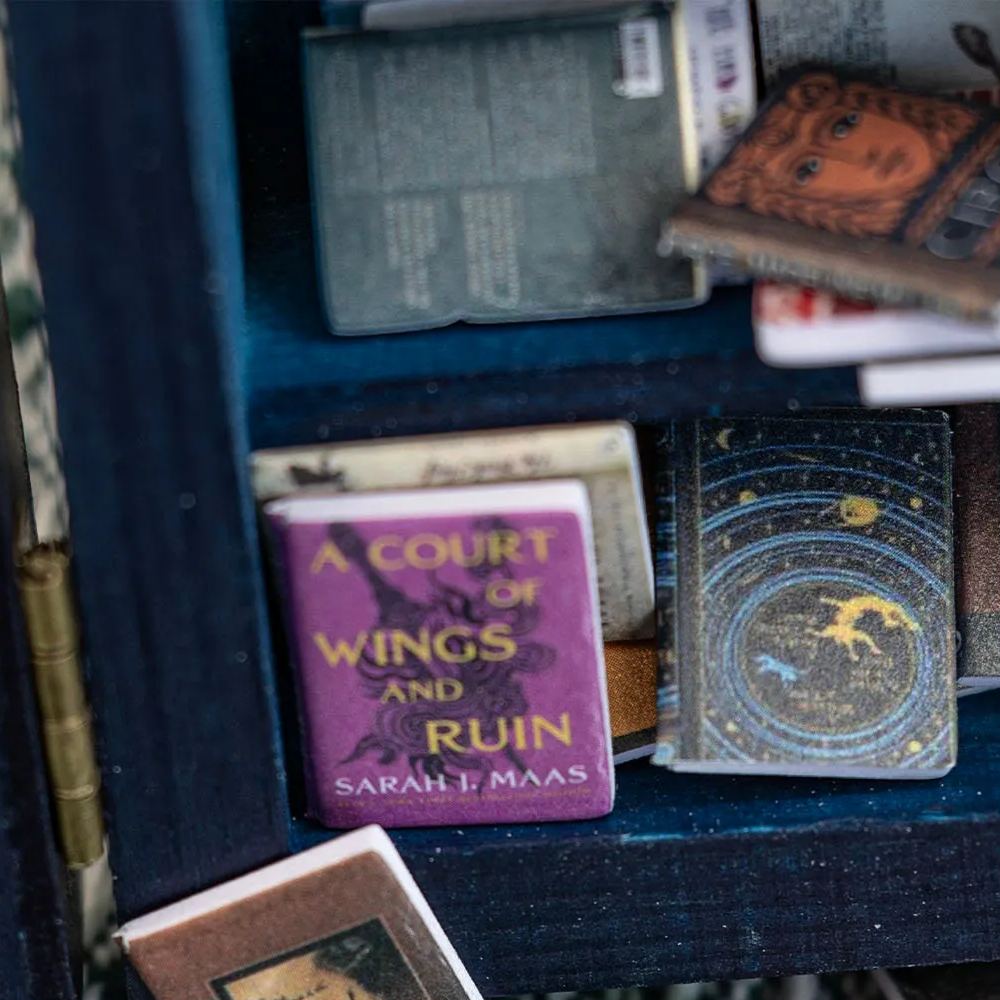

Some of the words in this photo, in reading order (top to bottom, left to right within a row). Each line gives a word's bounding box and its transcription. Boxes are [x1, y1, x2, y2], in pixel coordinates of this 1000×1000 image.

[310, 538, 350, 574] A
[367, 526, 558, 571] COURT
[484, 577, 544, 608] OF
[312, 622, 518, 668] WINGS
[380, 677, 464, 704] AND
[424, 710, 574, 755] RUIN
[333, 773, 446, 797] SARAH
[489, 763, 588, 788] MAAS
